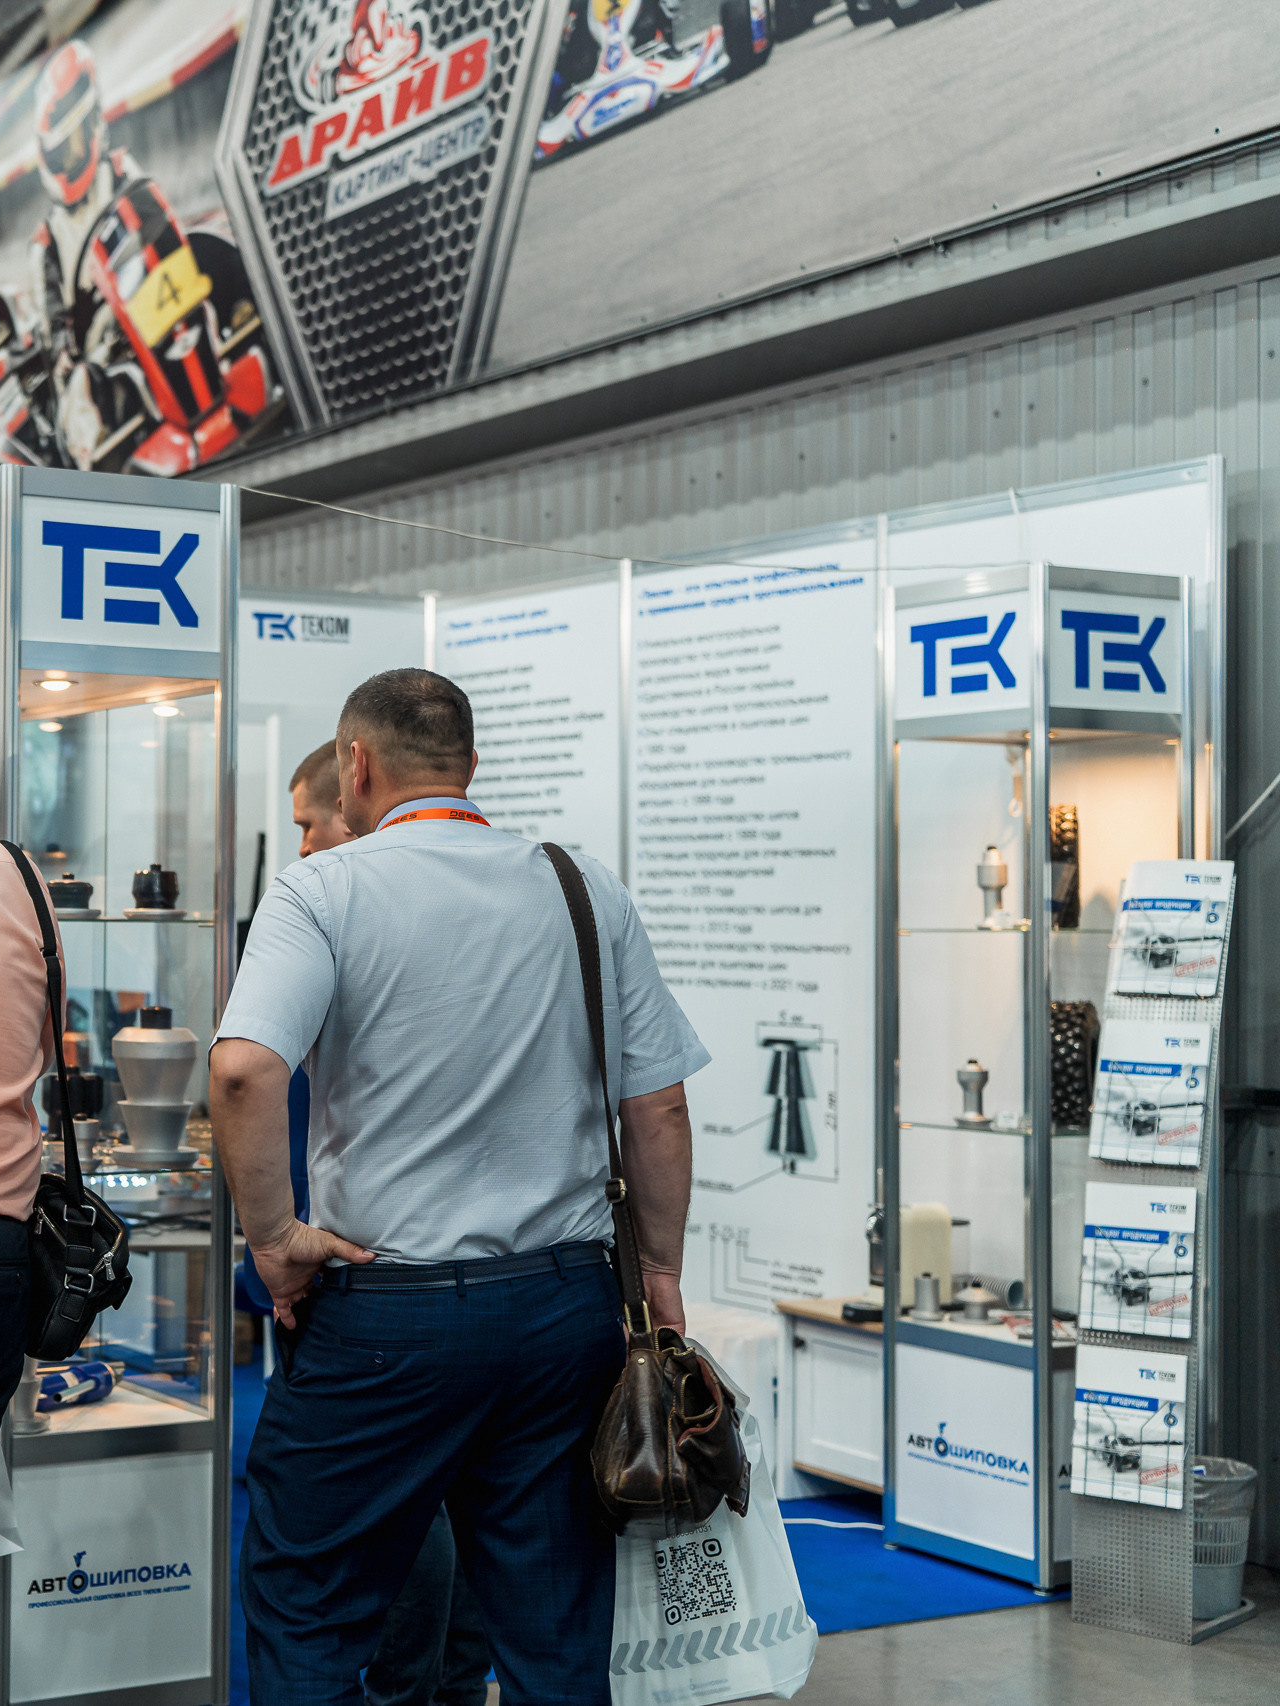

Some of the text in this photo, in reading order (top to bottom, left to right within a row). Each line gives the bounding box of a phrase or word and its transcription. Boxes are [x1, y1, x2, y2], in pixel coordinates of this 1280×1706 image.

[330, 115, 487, 208] КАРТИНГ-ЦЕНТР
[907, 1434, 1030, 1475] АВТОШИПОВКА
[28, 1562, 192, 1595] АВТОШИПОВКА
